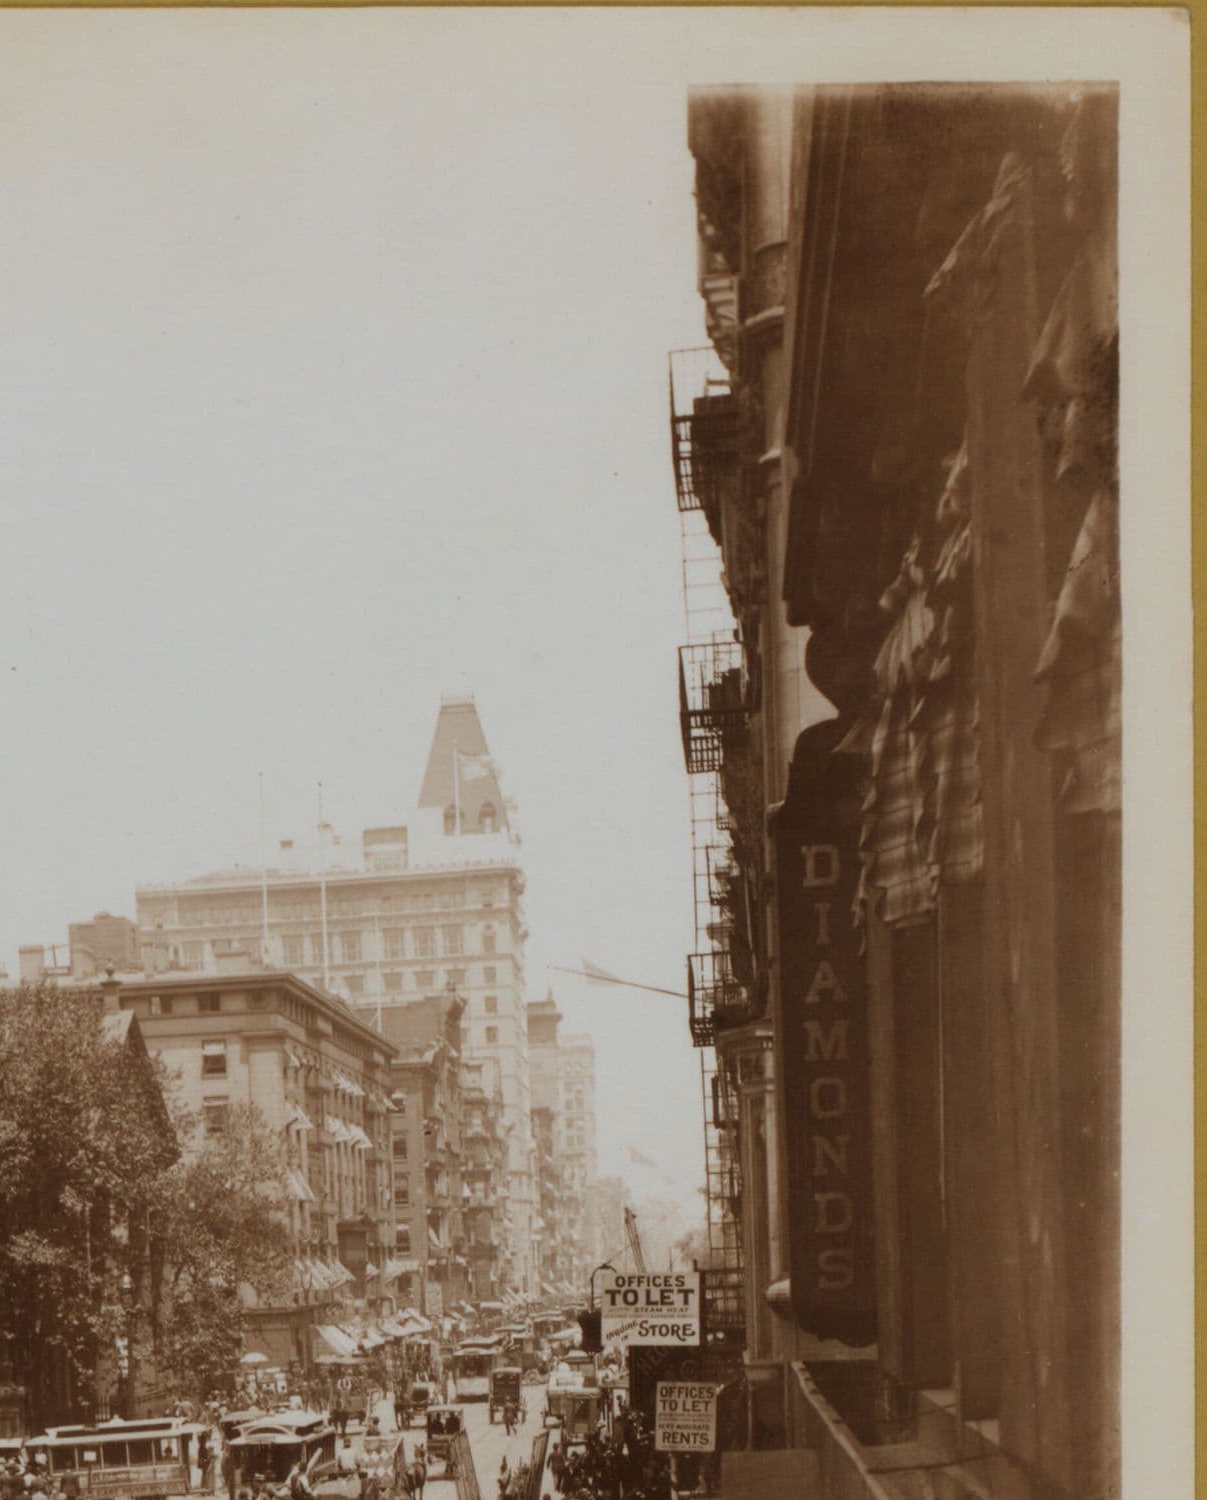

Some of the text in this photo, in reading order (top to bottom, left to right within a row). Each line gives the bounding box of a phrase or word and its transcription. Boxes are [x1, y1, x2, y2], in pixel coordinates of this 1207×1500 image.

[798, 843, 855, 1290] DIAMONDS
[614, 1275, 686, 1288] OFFICES
[605, 1288, 695, 1307] TO LET
[659, 1386, 714, 1400] OFFICES
[660, 1400, 711, 1412] TO LET
[662, 1432, 710, 1446] RENTS
